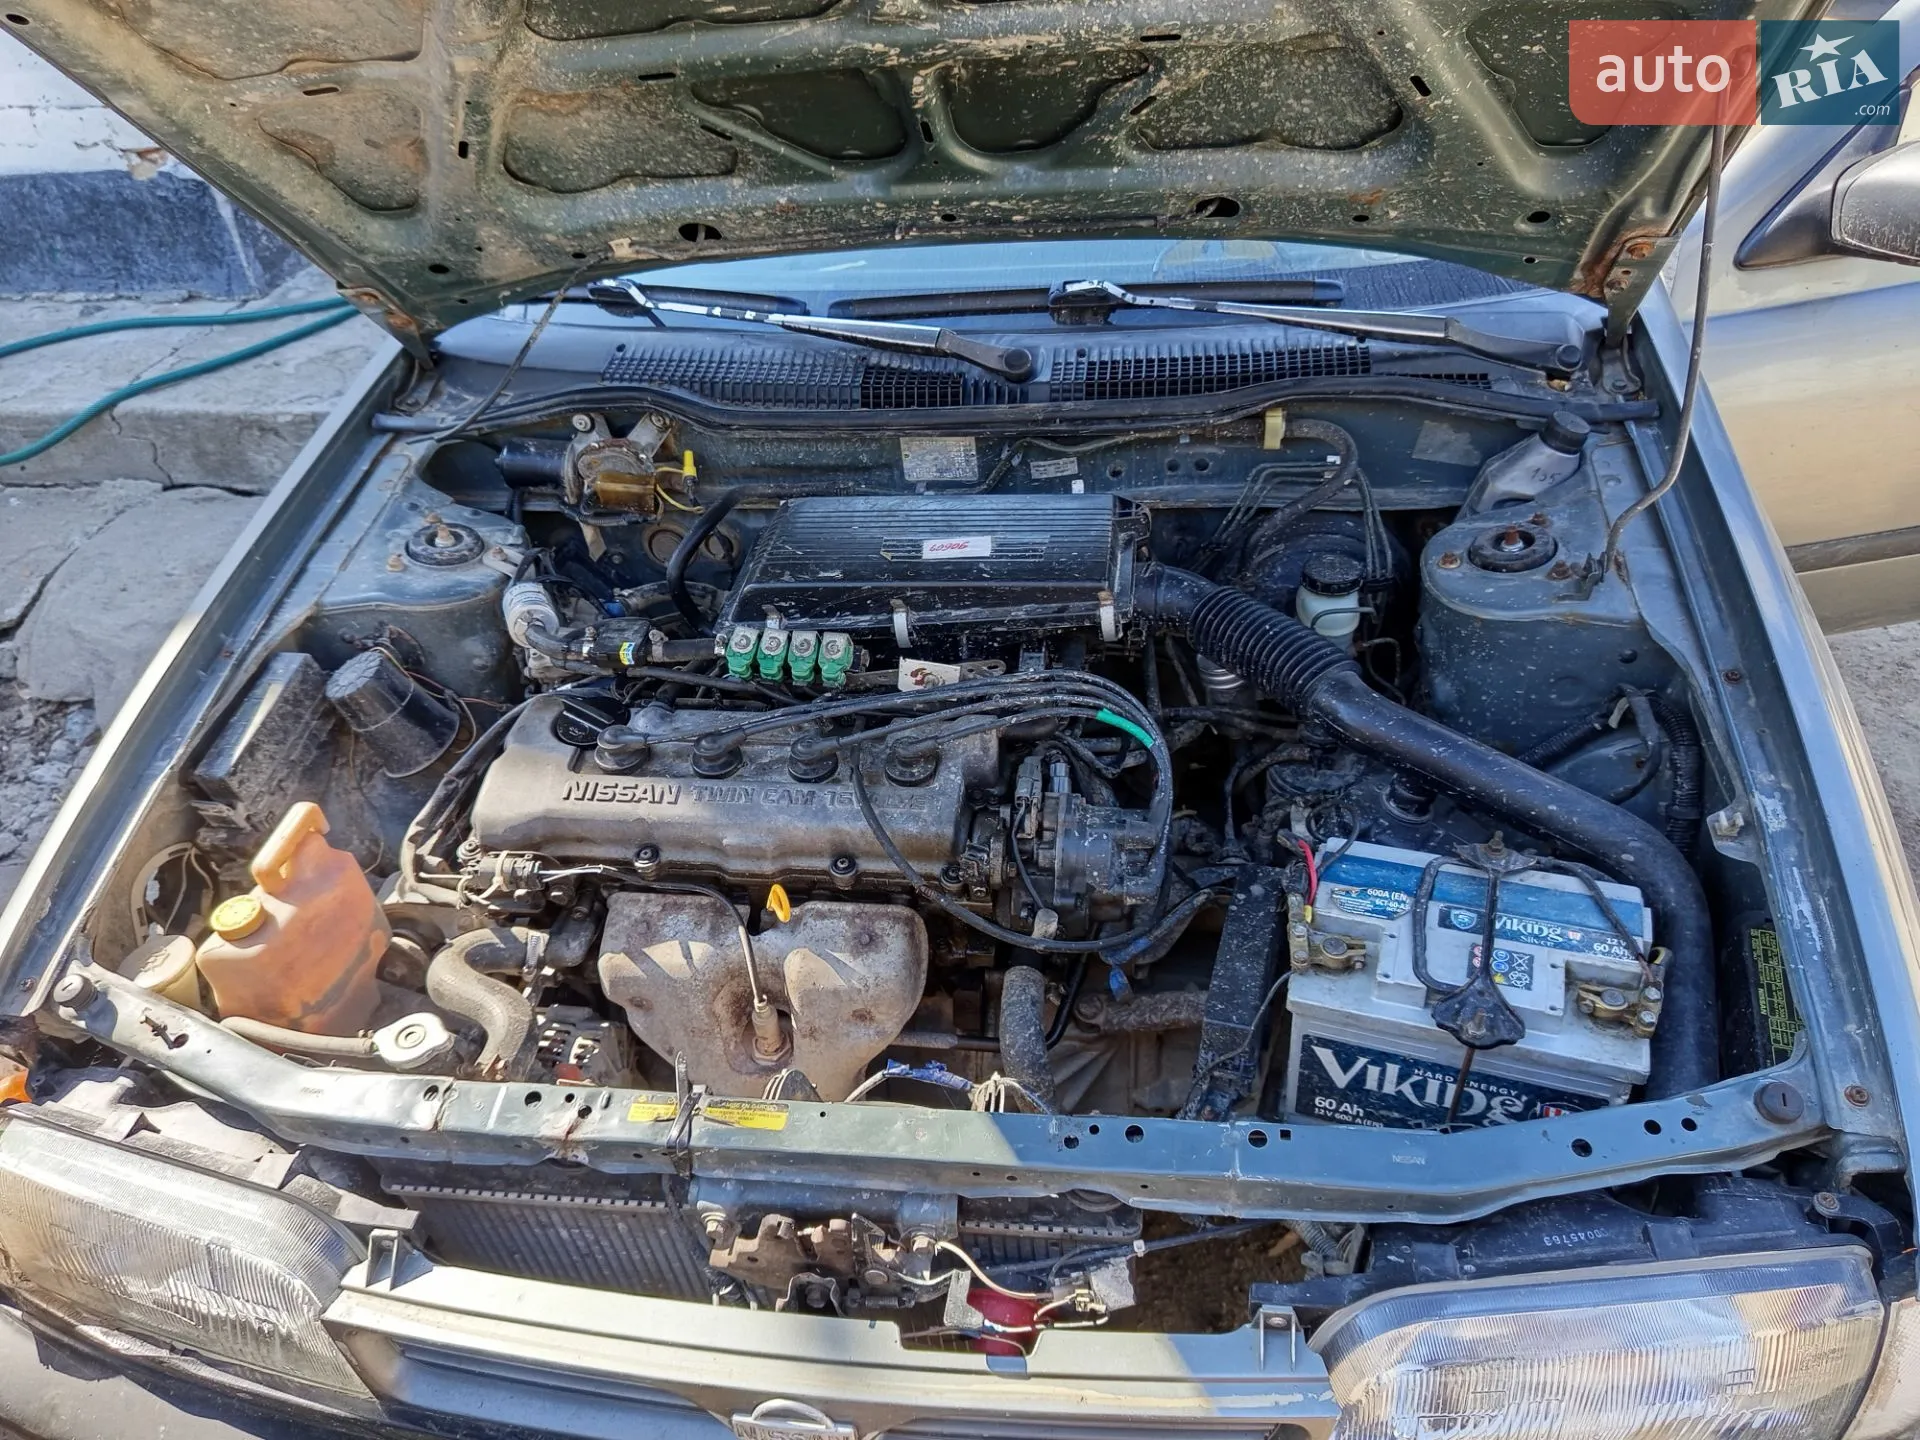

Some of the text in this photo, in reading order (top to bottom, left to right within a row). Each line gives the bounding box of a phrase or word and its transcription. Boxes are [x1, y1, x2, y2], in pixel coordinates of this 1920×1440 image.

[562, 780, 682, 805] NISSAN
[690, 785, 754, 804] TWIN
[760, 787, 817, 807] CAM
[1593, 942, 1610, 953] 60
[1414, 1068, 1519, 1097] HARD NERGY
[1314, 1096, 1364, 1117] 60 Ah
[1314, 1107, 1325, 1116] 12
[1334, 1112, 1353, 1122] 600
